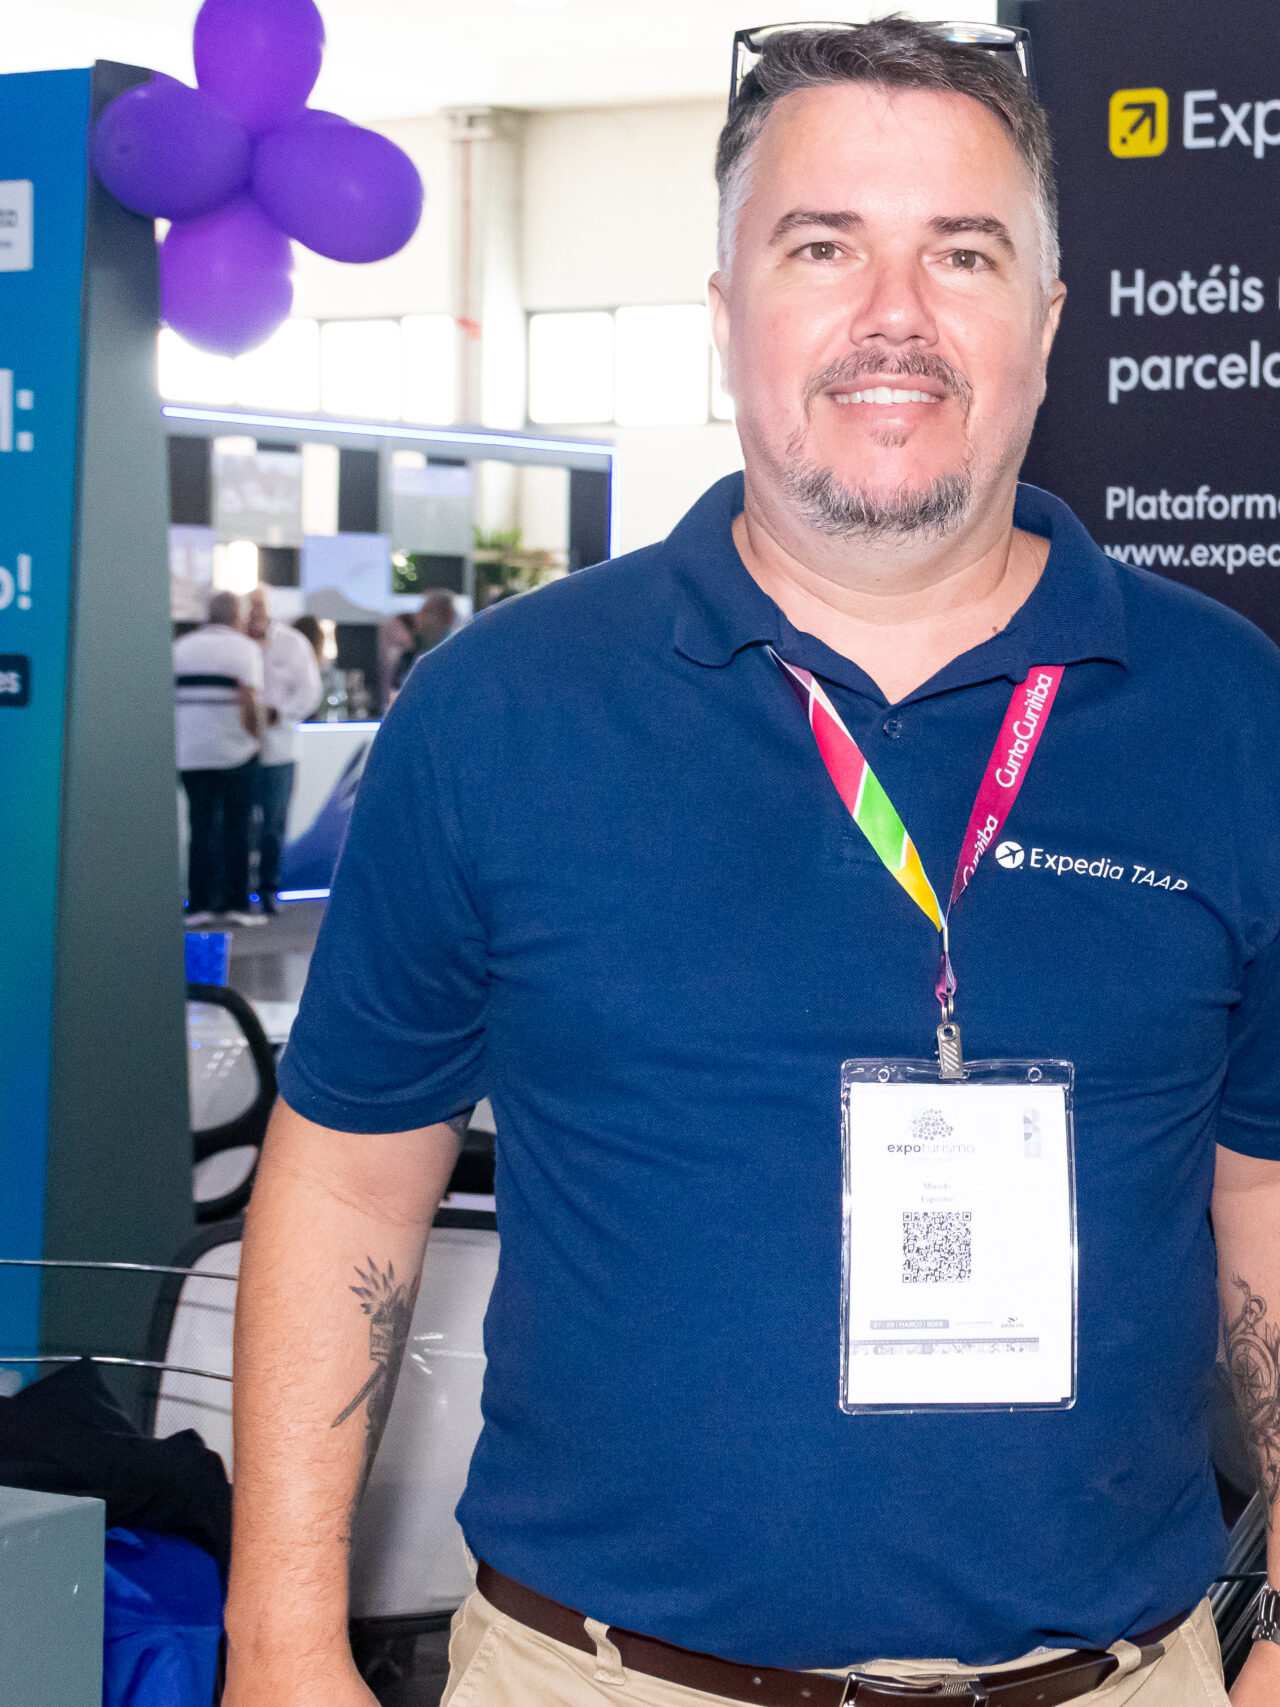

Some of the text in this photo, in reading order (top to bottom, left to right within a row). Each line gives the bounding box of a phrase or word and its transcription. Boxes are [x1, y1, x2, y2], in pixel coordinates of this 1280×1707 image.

[1110, 264, 1264, 317] Hotéis
[1029, 847, 1189, 891] Expedia TAAP
